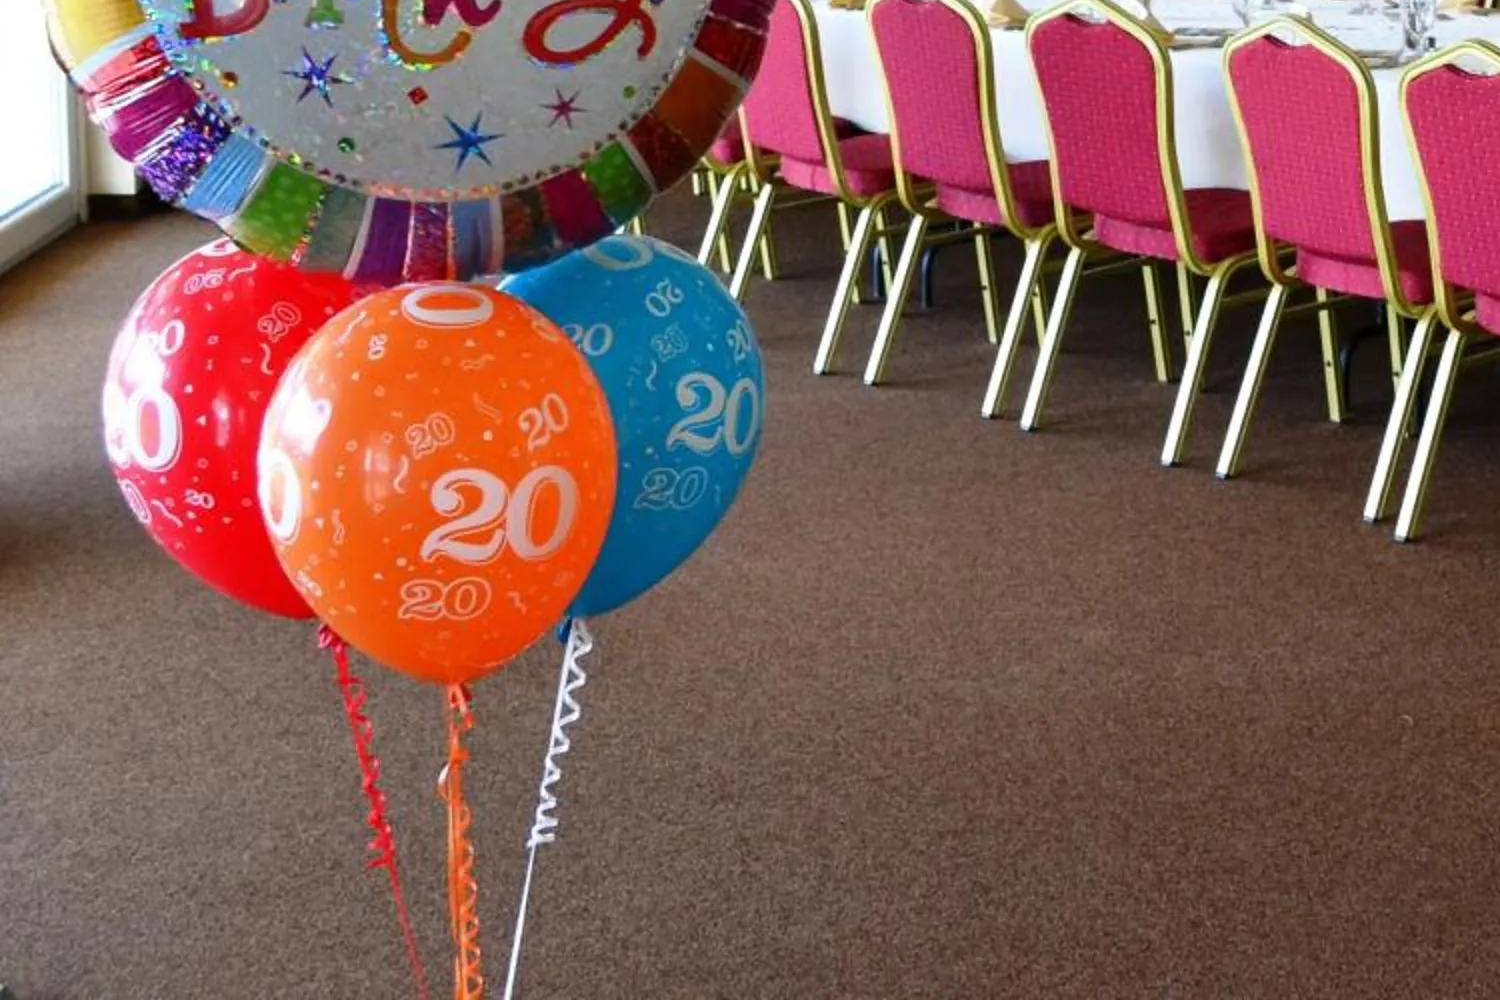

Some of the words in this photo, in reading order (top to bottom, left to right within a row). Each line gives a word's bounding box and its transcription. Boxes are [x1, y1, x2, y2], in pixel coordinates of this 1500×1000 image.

[258, 301, 301, 343] 20
[405, 411, 456, 460] 20
[518, 391, 569, 452] 20
[666, 371, 761, 459] 20
[632, 466, 709, 511] 20
[420, 466, 580, 566] 20
[398, 576, 492, 622] 20
